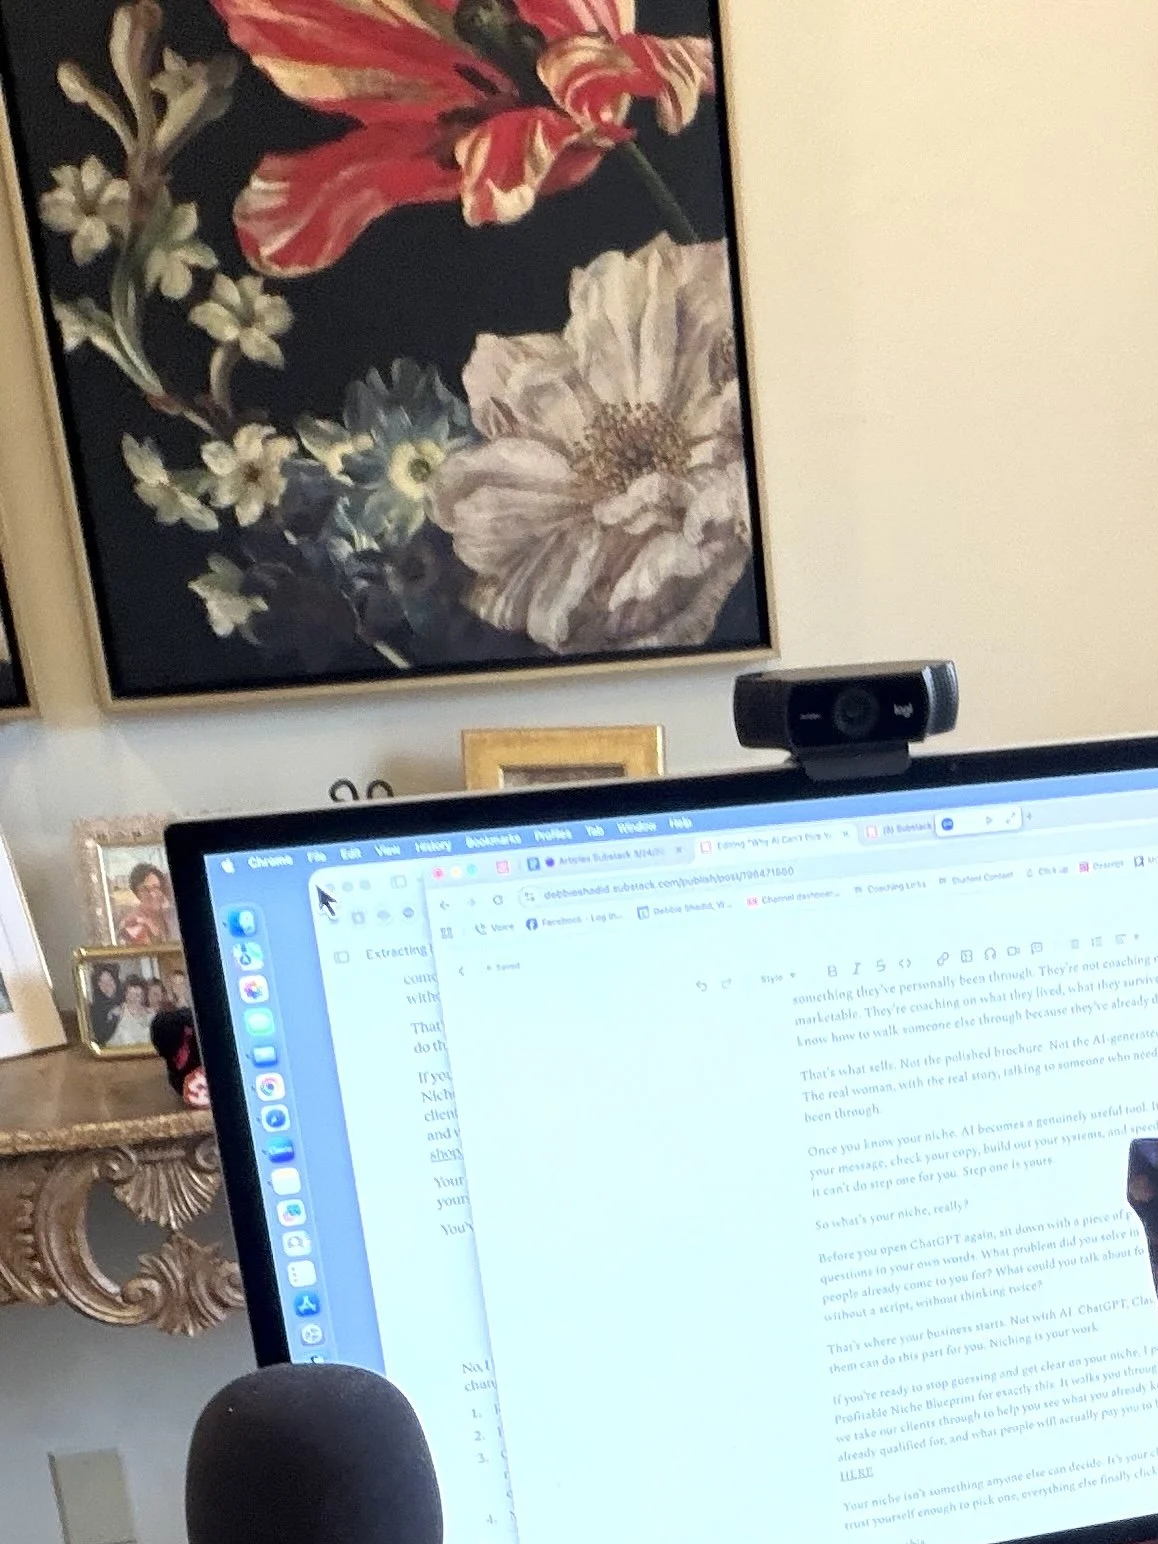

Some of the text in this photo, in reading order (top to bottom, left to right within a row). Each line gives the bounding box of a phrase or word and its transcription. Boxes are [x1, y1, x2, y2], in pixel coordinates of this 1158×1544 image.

[248, 816, 693, 869] Chrome File Edit View History Bookmarks Profiles Tab Window Help
[366, 944, 428, 960] Extracting
[792, 988, 853, 1005] something
[856, 983, 896, 999] they've
[898, 975, 956, 996] personally
[958, 973, 985, 986] been
[1039, 961, 1078, 977] They're
[1081, 960, 1099, 972] not
[1102, 955, 1150, 969] coaching
[414, 1042, 431, 1054] do
[427, 1128, 451, 1141] and
[809, 1166, 834, 1180] your
[889, 1151, 922, 1166] check
[924, 1151, 949, 1165] your
[982, 1139, 1011, 1154] build
[1013, 1139, 1031, 1150] out
[1034, 1135, 1058, 1150] your
[1107, 1123, 1127, 1138] and
[434, 1175, 465, 1188] Your
[815, 1219, 829, 1230] So
[831, 1213, 867, 1228] what's
[869, 1211, 894, 1225] your
[818, 1250, 854, 1263] Before
[856, 1248, 877, 1261] you
[879, 1243, 907, 1256] open
[909, 1232, 961, 1250] ChatGPT
[999, 1227, 1012, 1237] sit
[1015, 1223, 1044, 1235] down
[1046, 1216, 1070, 1230] with
[1082, 1214, 1110, 1228] piece
[1111, 1209, 1124, 1221] of
[822, 1288, 858, 1306] people
[861, 1282, 900, 1297] already
[903, 1279, 932, 1291] come
[935, 1277, 947, 1286] to
[948, 1273, 968, 1287] you
[995, 1263, 1024, 1277] What
[1026, 1257, 1056, 1273] could
[1057, 1257, 1077, 1270] you
[1079, 1251, 1099, 1265] talk
[1102, 1248, 1131, 1261] about
[823, 1308, 867, 1322] without
[915, 1293, 957, 1308] without
[959, 1287, 1005, 1302] thinking
[834, 1407, 888, 1423] Profitable
[890, 1401, 922, 1415] Niche
[925, 1394, 975, 1410] Blueprint
[977, 1389, 993, 1401] for
[995, 1383, 1032, 1398] exactly
[1060, 1376, 1068, 1388] It
[1070, 1371, 1100, 1385] walks
[1102, 1370, 1121, 1383] you
[837, 1447, 876, 1462] already
[879, 1437, 926, 1458] qualified
[949, 1430, 968, 1444] and
[971, 1427, 997, 1439] what
[1000, 1419, 1034, 1438] people
[1036, 1415, 1056, 1428] will
[1059, 1408, 1098, 1425] actually
[1101, 1407, 1118, 1420] pay
[1120, 1404, 1139, 1417] you
[1141, 1401, 1152, 1411] to
[839, 1466, 874, 1482] HERE
[844, 1518, 869, 1530] trust
[871, 1508, 914, 1528] yourself
[917, 1501, 956, 1518] enough
[958, 1501, 970, 1510] to
[972, 1493, 994, 1511] pick
[1021, 1482, 1076, 1499] everything
[1077, 1477, 1097, 1489] else
[1100, 1470, 1130, 1485] finally
